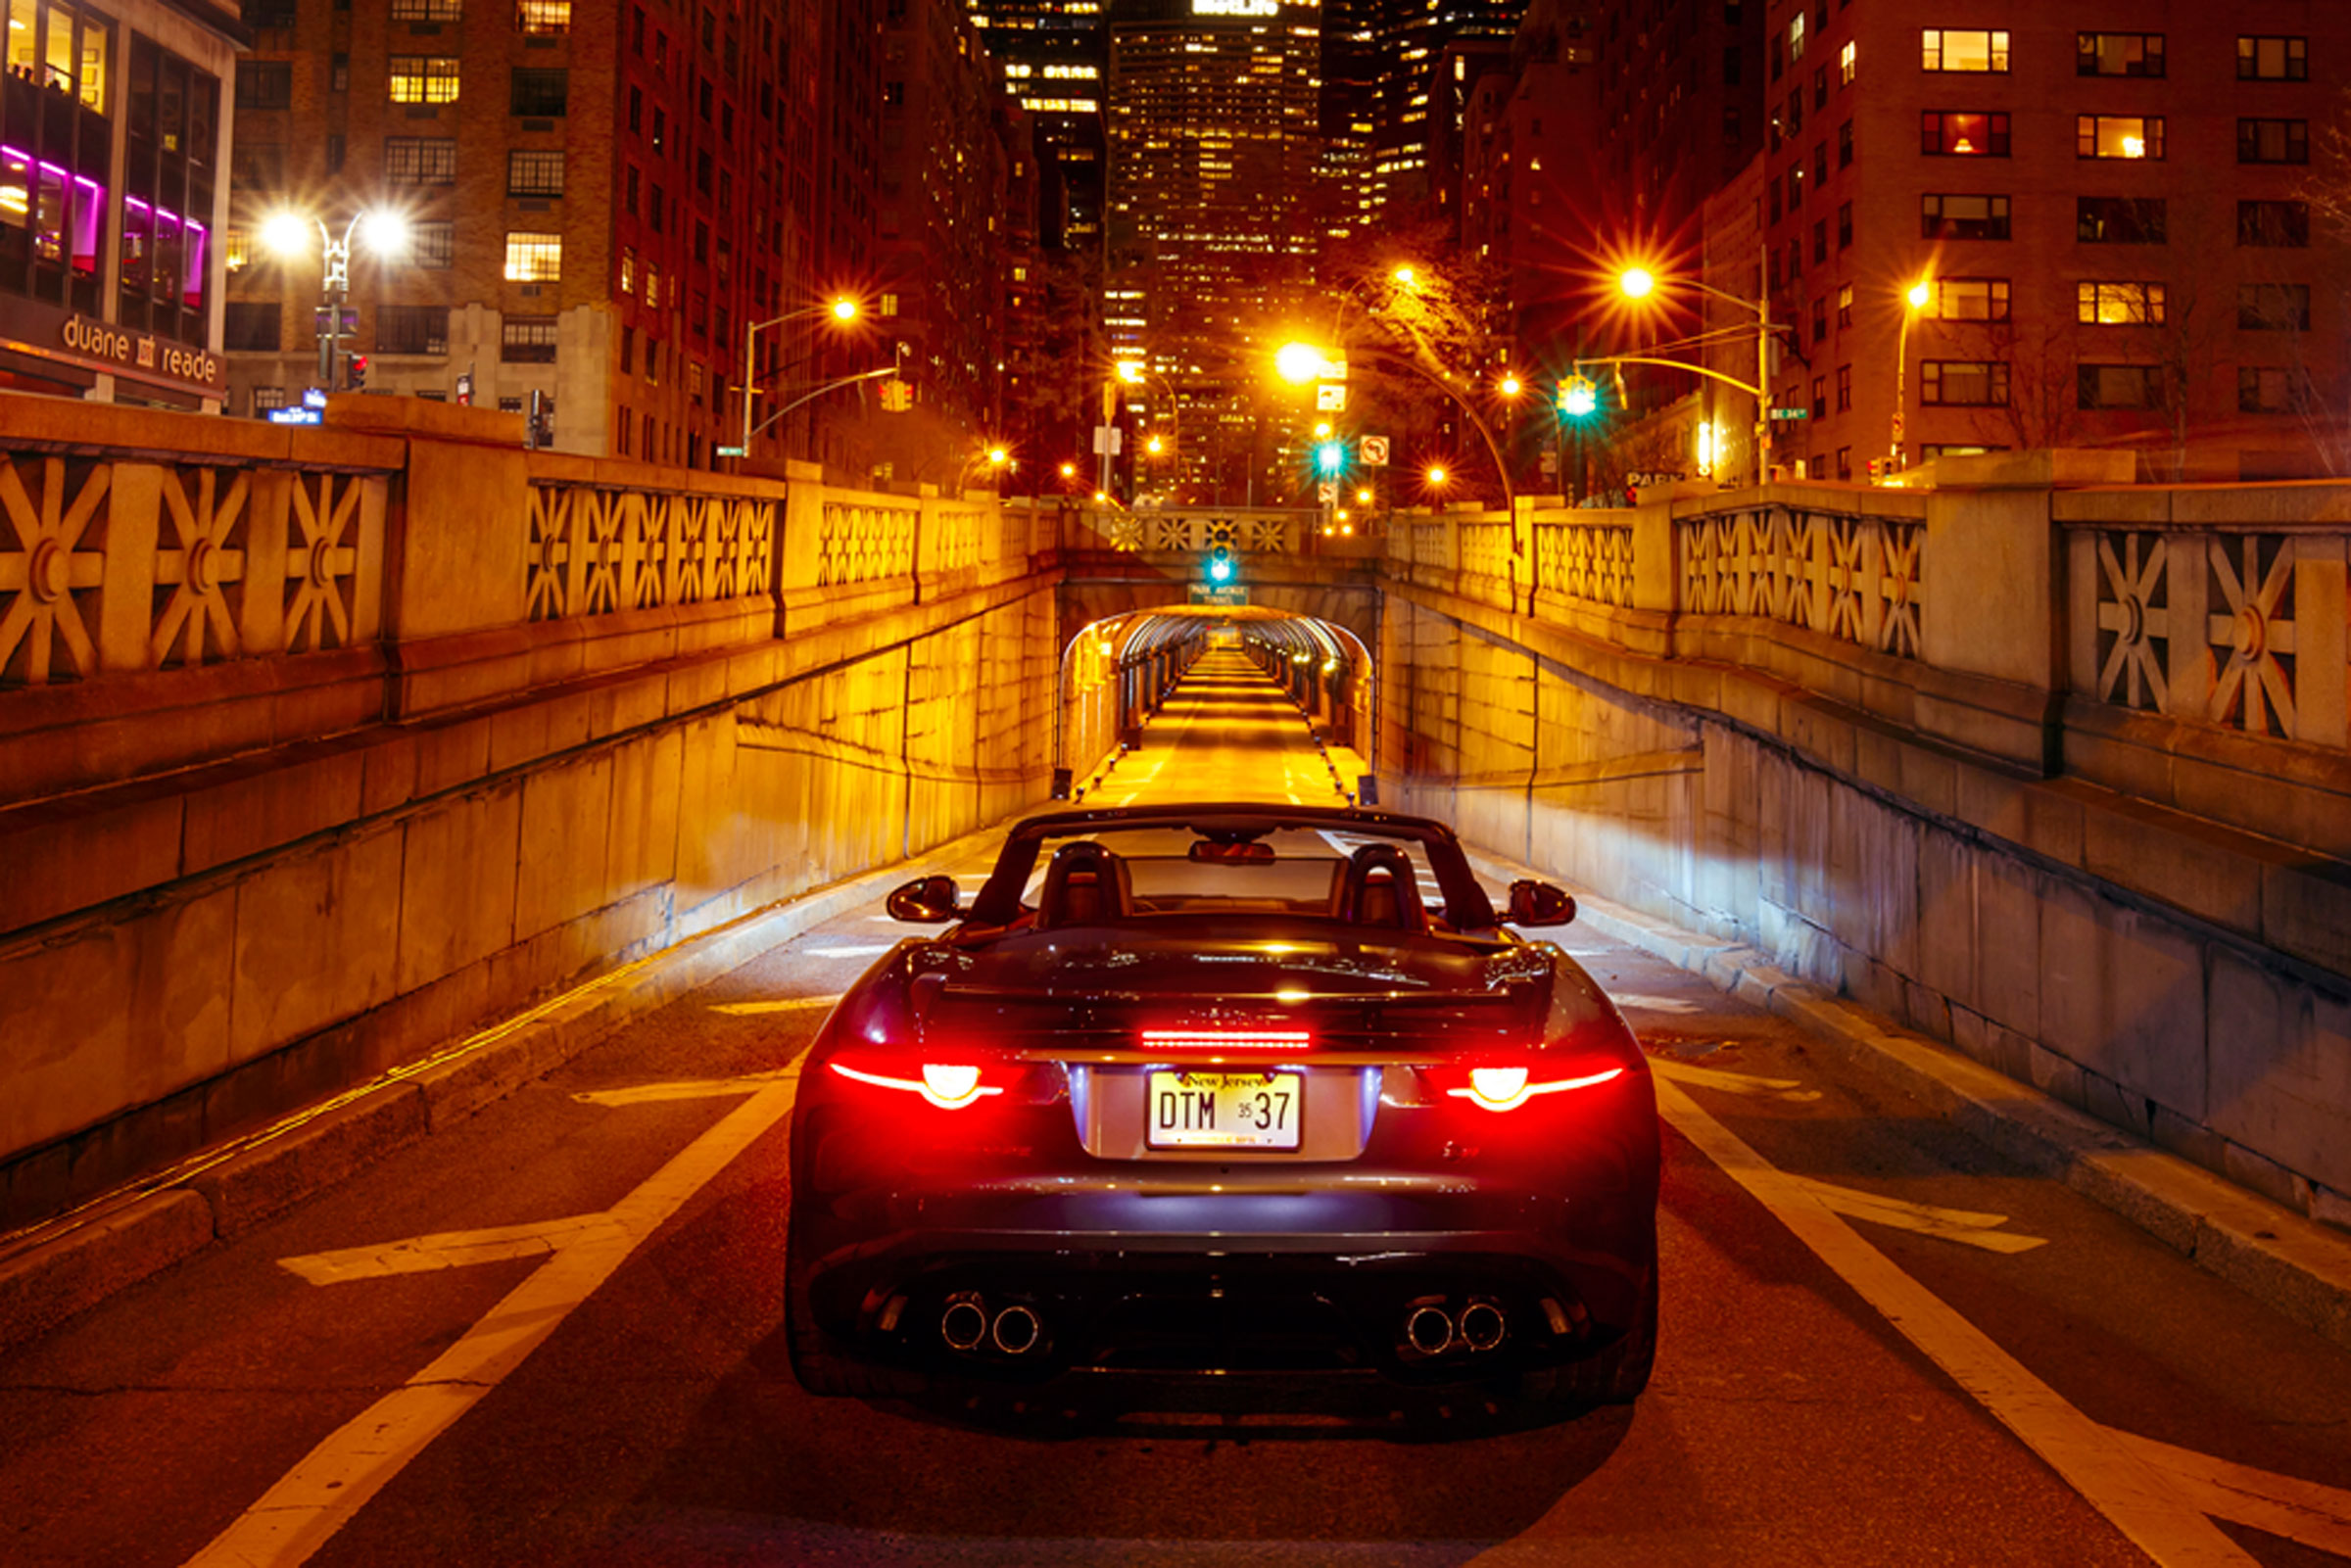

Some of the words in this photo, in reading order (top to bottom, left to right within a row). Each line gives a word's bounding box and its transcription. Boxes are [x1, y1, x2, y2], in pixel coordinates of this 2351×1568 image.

[64, 313, 128, 360] duane
[163, 349, 216, 383] reade
[1187, 1074, 1220, 1087] New
[1221, 1075, 1263, 1089] Jersey
[1160, 1091, 1215, 1129] DTM
[1255, 1092, 1290, 1130] 37
